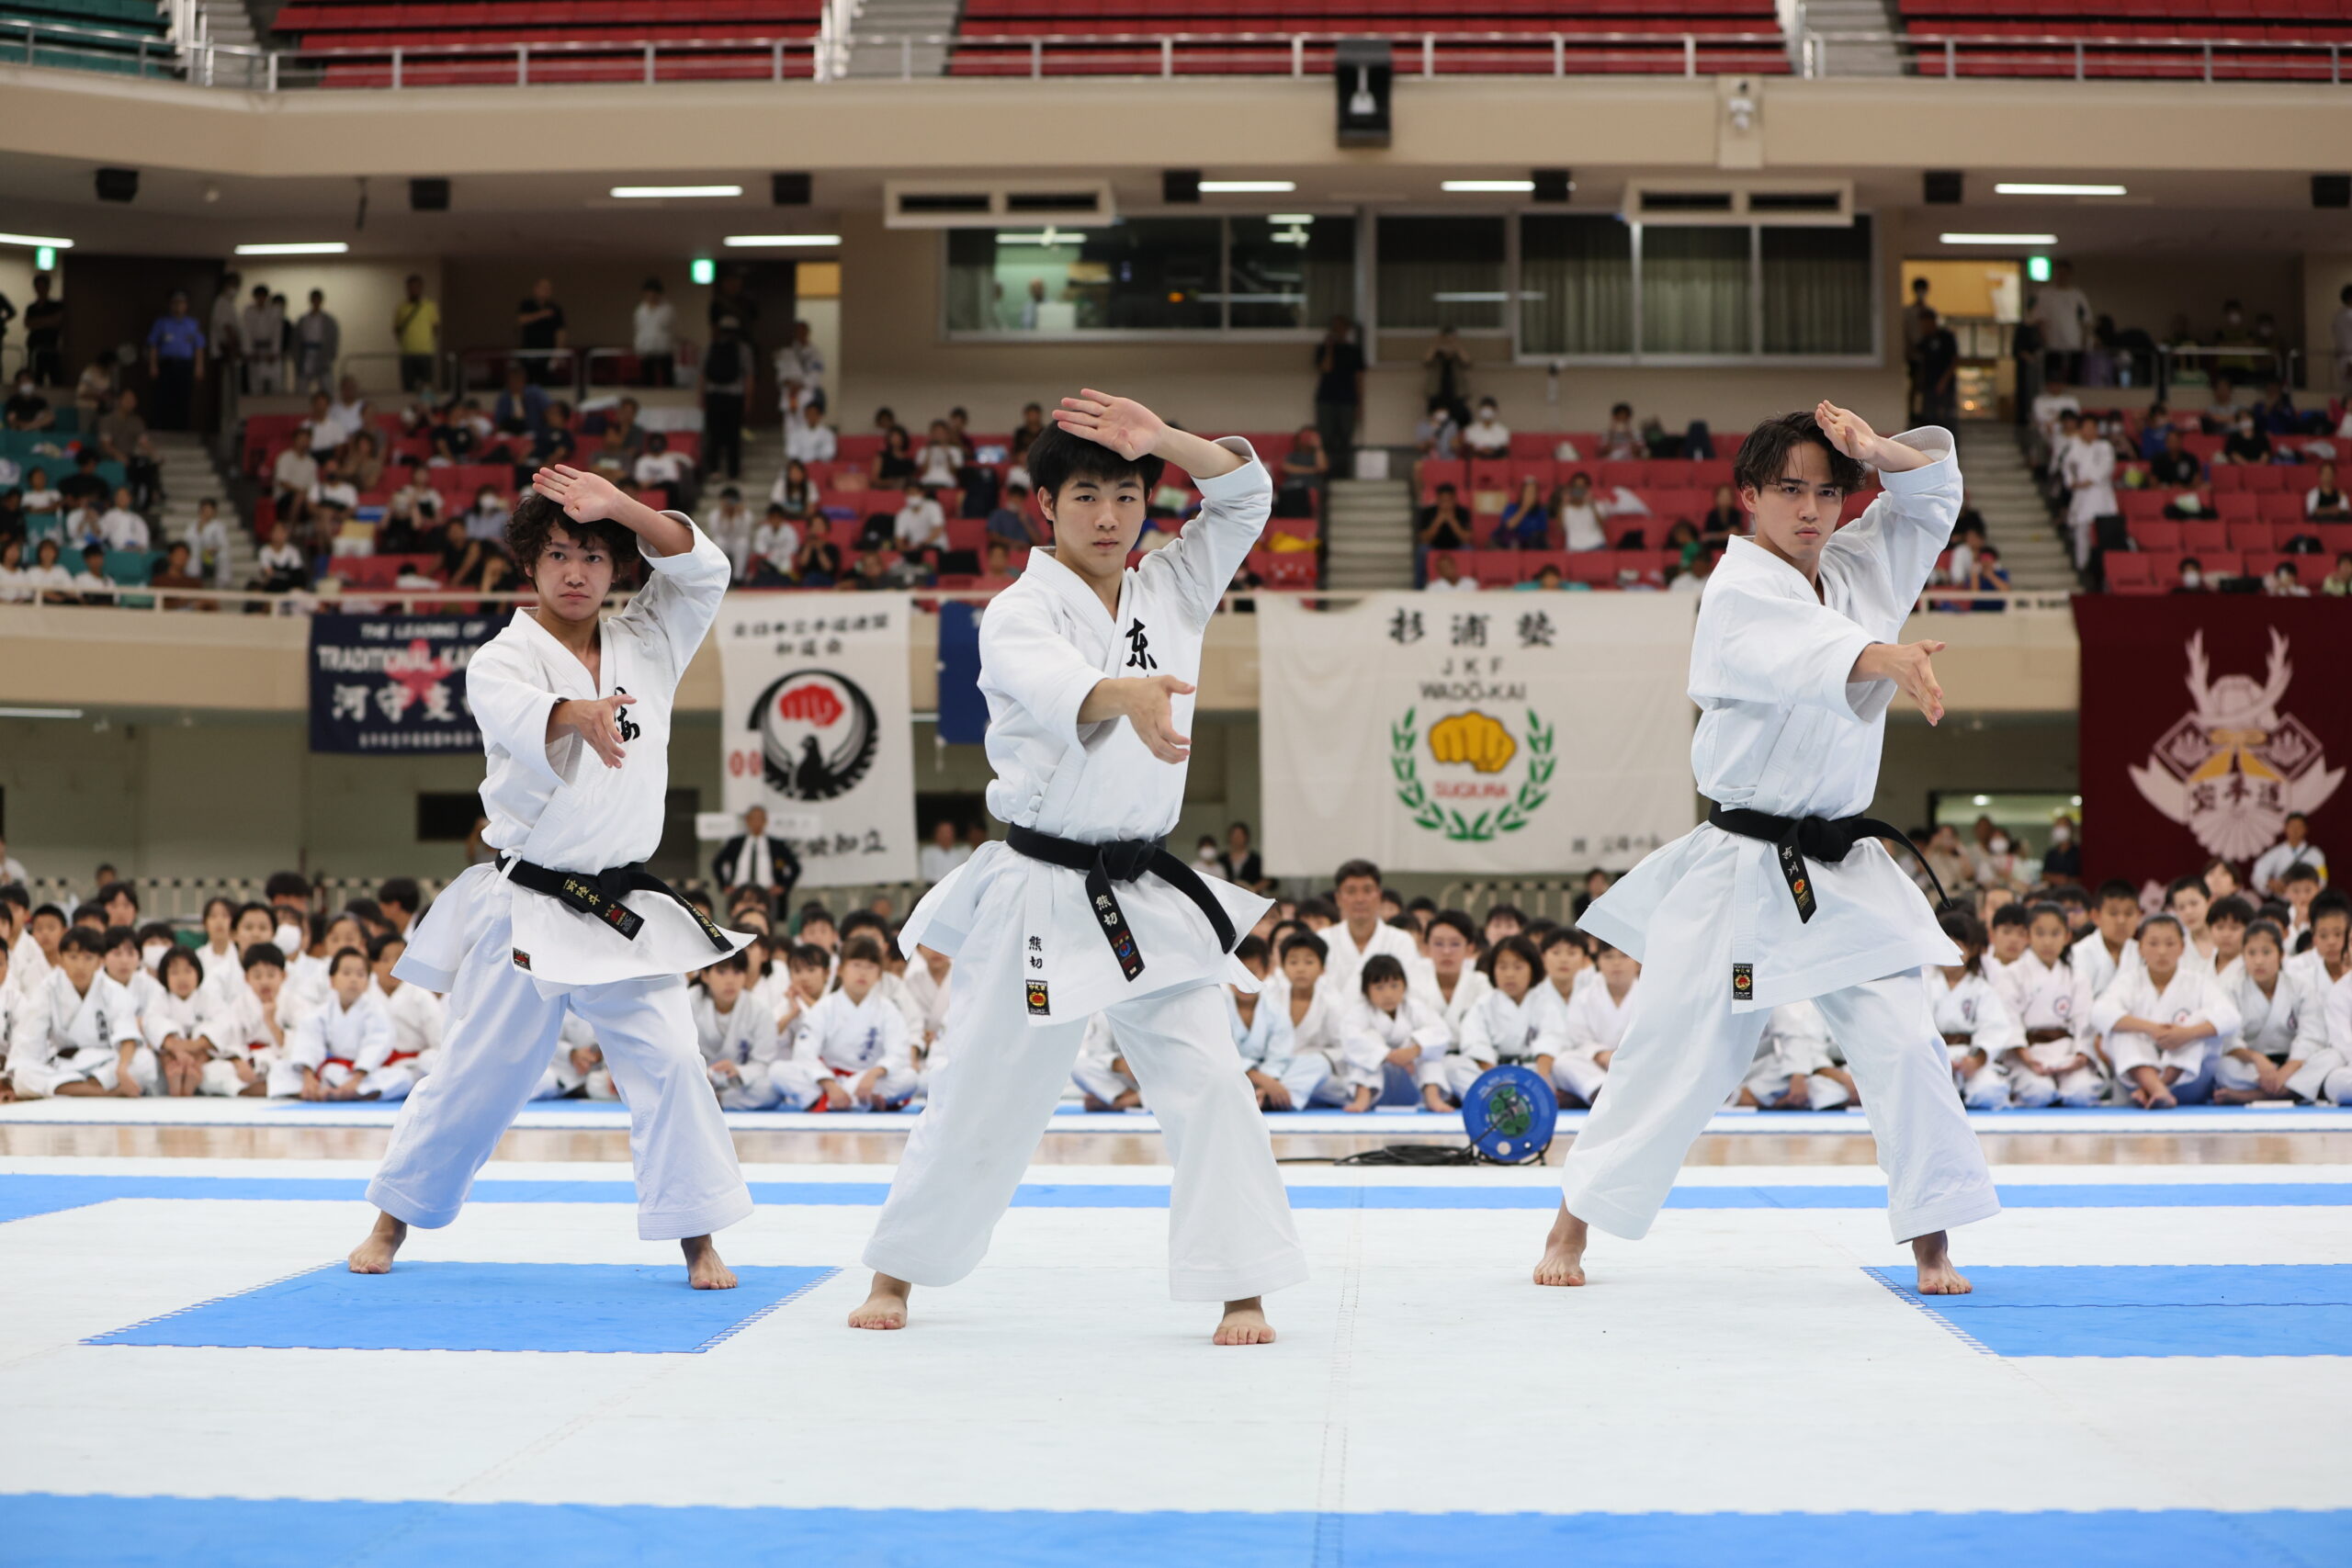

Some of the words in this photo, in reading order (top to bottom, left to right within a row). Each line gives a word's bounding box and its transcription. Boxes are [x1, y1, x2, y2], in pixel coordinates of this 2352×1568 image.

[359, 623, 390, 639] THE
[462, 621, 487, 638] OF
[1387, 606, 1556, 649] 杉浦塾
[317, 646, 435, 671] TRADITIONAL
[563, 879, 600, 906] 野陸斗
[1096, 895, 1118, 927] 熊切
[1028, 936, 1043, 969] 熊切
